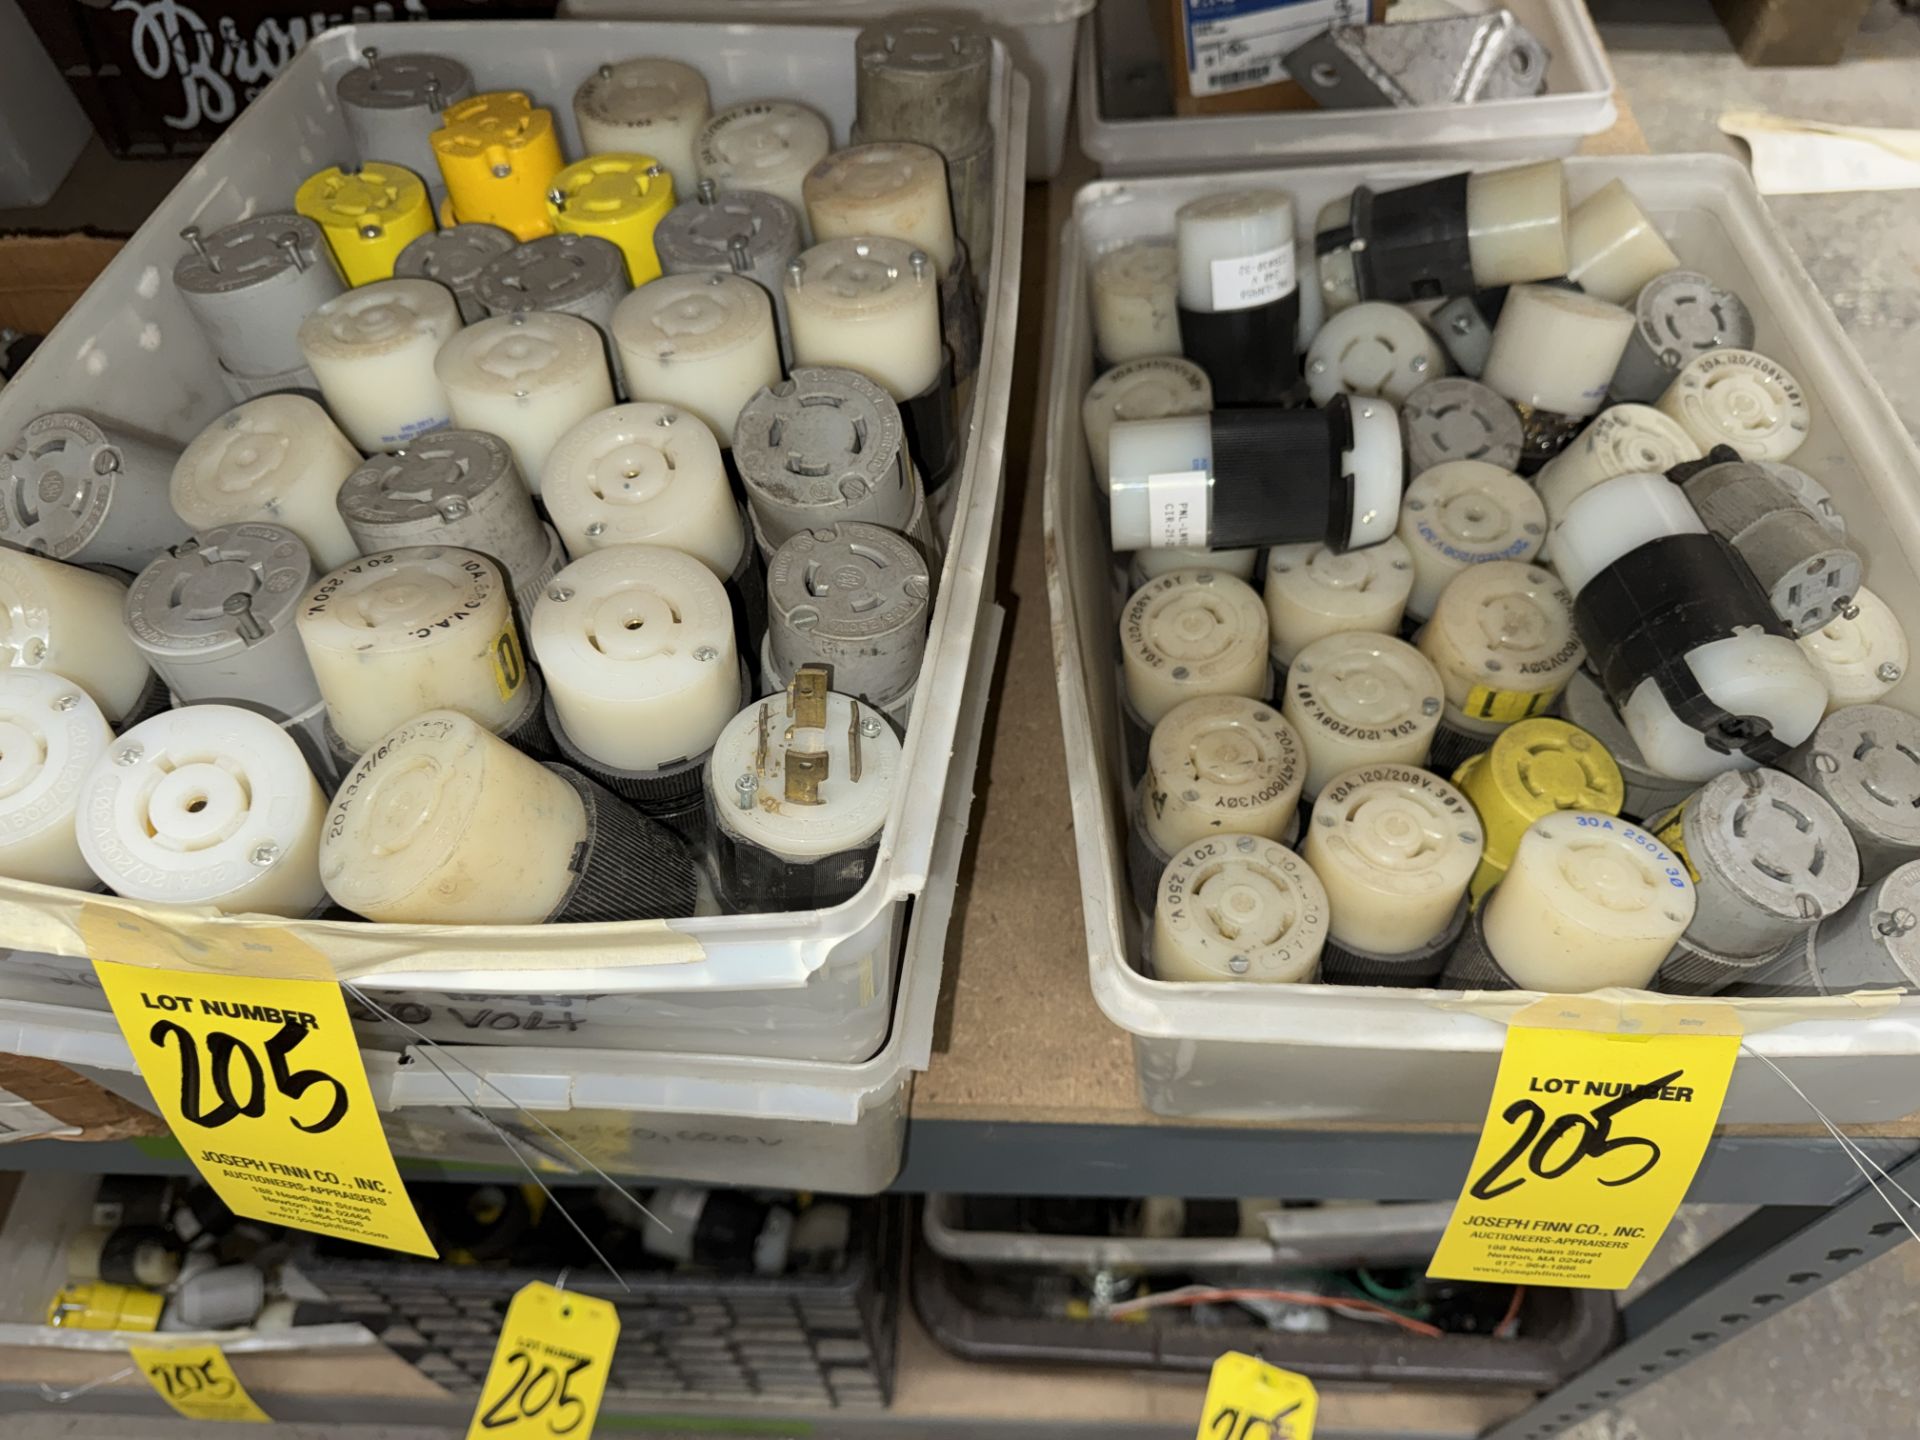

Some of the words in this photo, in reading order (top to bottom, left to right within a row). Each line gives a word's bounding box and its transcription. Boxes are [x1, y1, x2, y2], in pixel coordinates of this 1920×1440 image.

[1576, 816, 1614, 831] 30A
[1623, 828, 1670, 862] 250V
[140, 992, 194, 1013] LOT
[199, 999, 321, 1031] NUMBER
[149, 1019, 349, 1134] 205
[1528, 1077, 1580, 1095] LOT
[1469, 1069, 1685, 1201] 205
[201, 1150, 267, 1174] JOSEPH
[268, 1161, 311, 1181] FINN
[354, 1176, 393, 1195] INC.
[222, 1168, 388, 1207] AUCTIONEERS-APPRAISERS
[1462, 1215, 1530, 1230] JOSEPH
[1531, 1219, 1574, 1234] FINN
[1612, 1225, 1647, 1239] INC.
[1469, 1230, 1631, 1250] AUCTIONEERS-APPRAISERS
[150, 1357, 237, 1400] 205
[481, 1352, 593, 1435] 205
